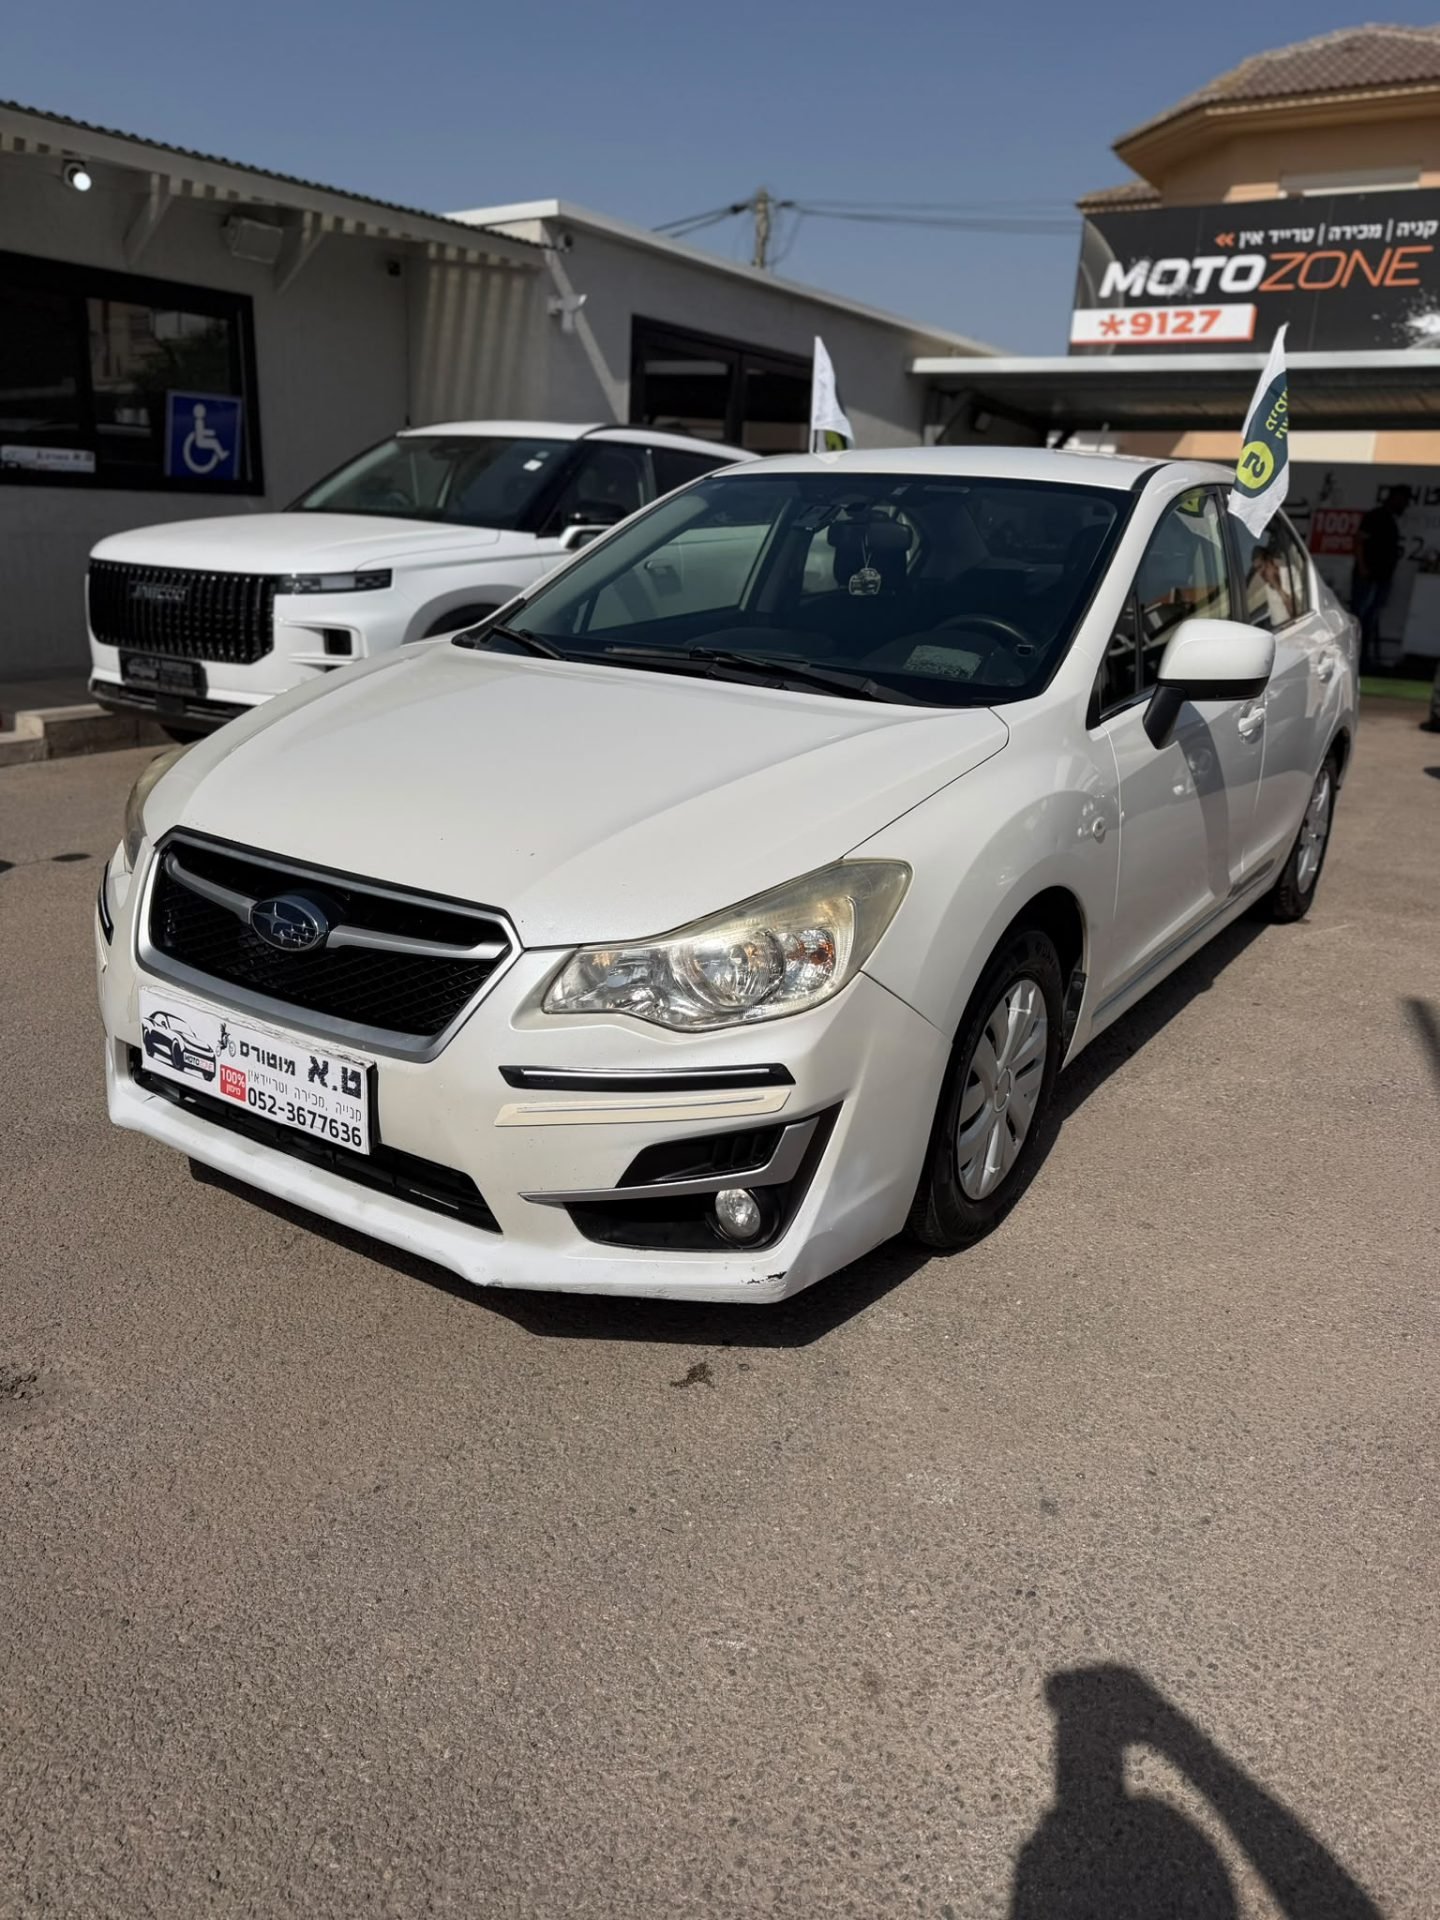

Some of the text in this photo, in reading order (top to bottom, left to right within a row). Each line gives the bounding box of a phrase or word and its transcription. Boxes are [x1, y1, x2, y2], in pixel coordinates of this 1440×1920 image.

[1239, 220, 1438, 249] קניה מכירה טרייד אין
[1099, 245, 1433, 298] MOTOZONE
[239, 1040, 296, 1076] מוטורס
[220, 1067, 246, 1088] 100%
[247, 1087, 362, 1147] 052-3677636
